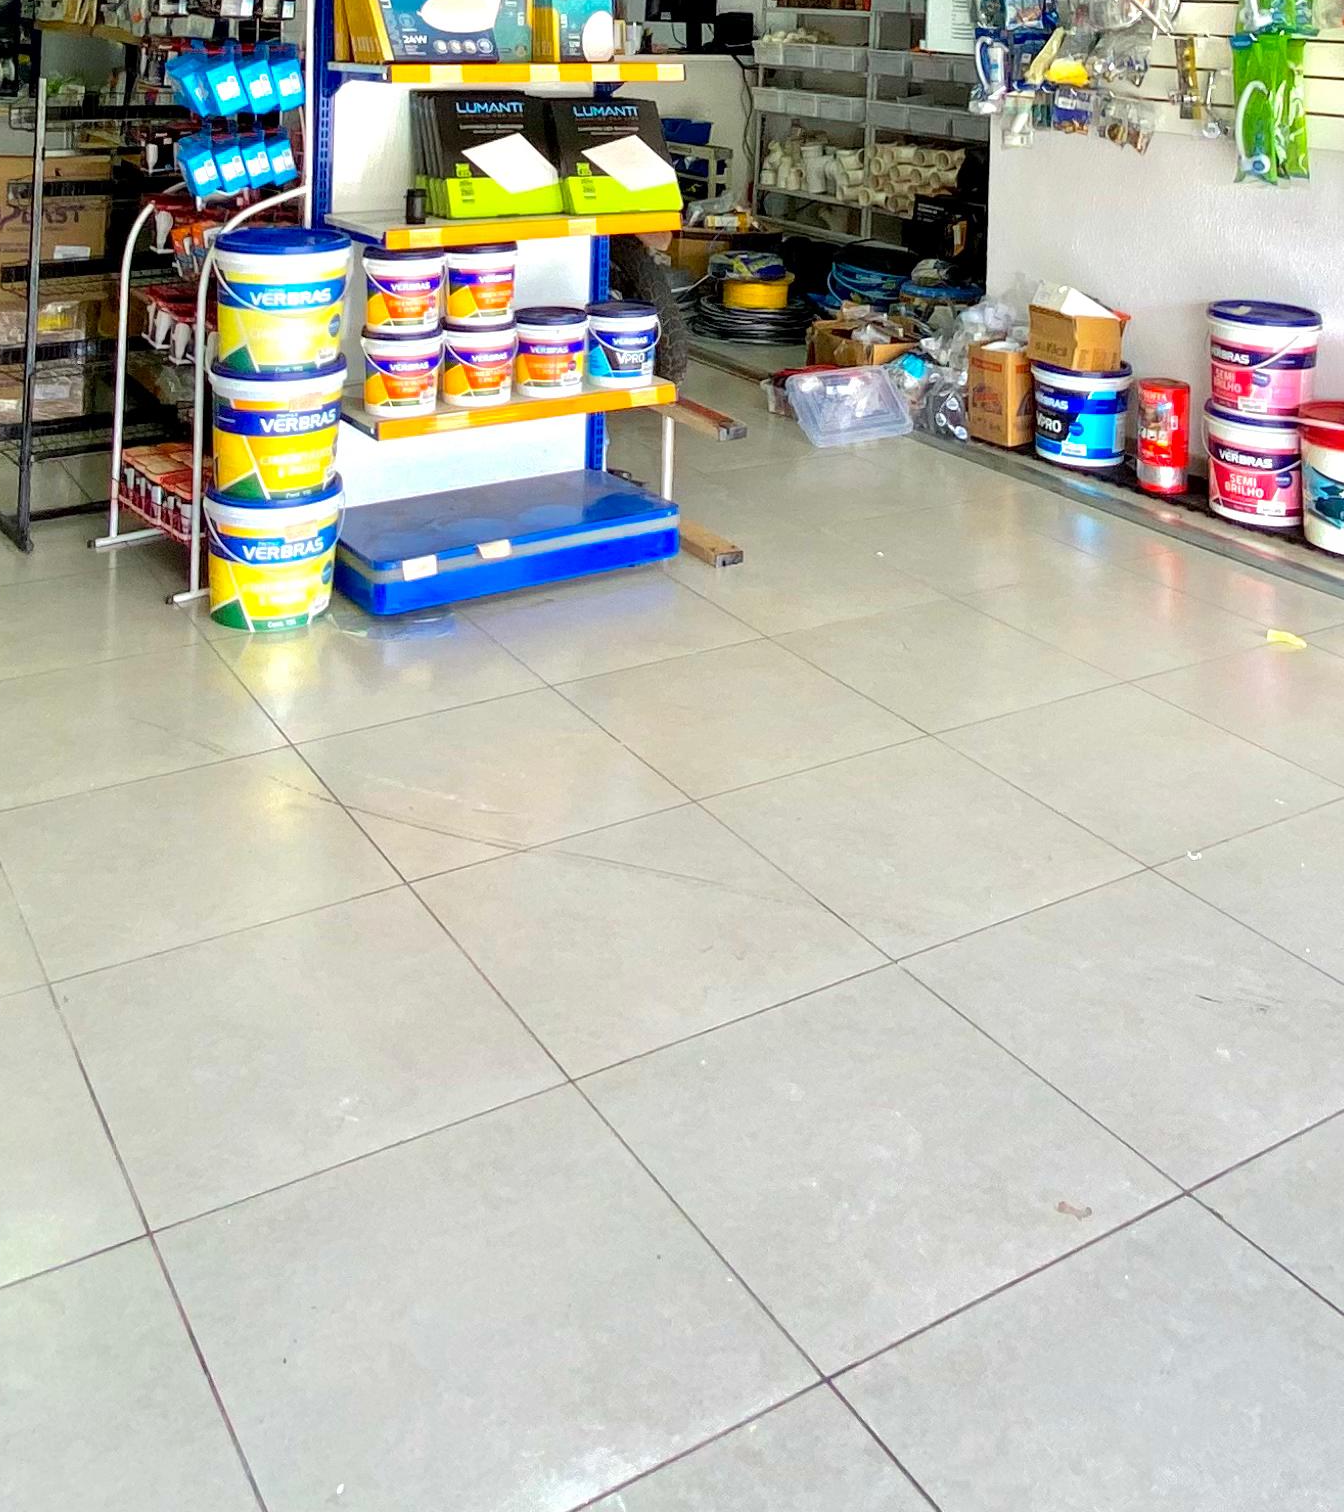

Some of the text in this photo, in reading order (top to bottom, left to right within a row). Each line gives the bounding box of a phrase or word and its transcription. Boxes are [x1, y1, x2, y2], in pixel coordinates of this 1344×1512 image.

[456, 101, 524, 115] LUMANTI
[573, 105, 639, 117] LUMANTI
[249, 287, 332, 307] VERBRAS
[615, 352, 646, 365] VPRO
[259, 408, 337, 433] VERBRAS
[1218, 448, 1273, 469] VERBRAS
[1229, 473, 1257, 487] SEMI
[1224, 482, 1265, 499] BRILHO
[242, 537, 324, 561] VERBRAS
